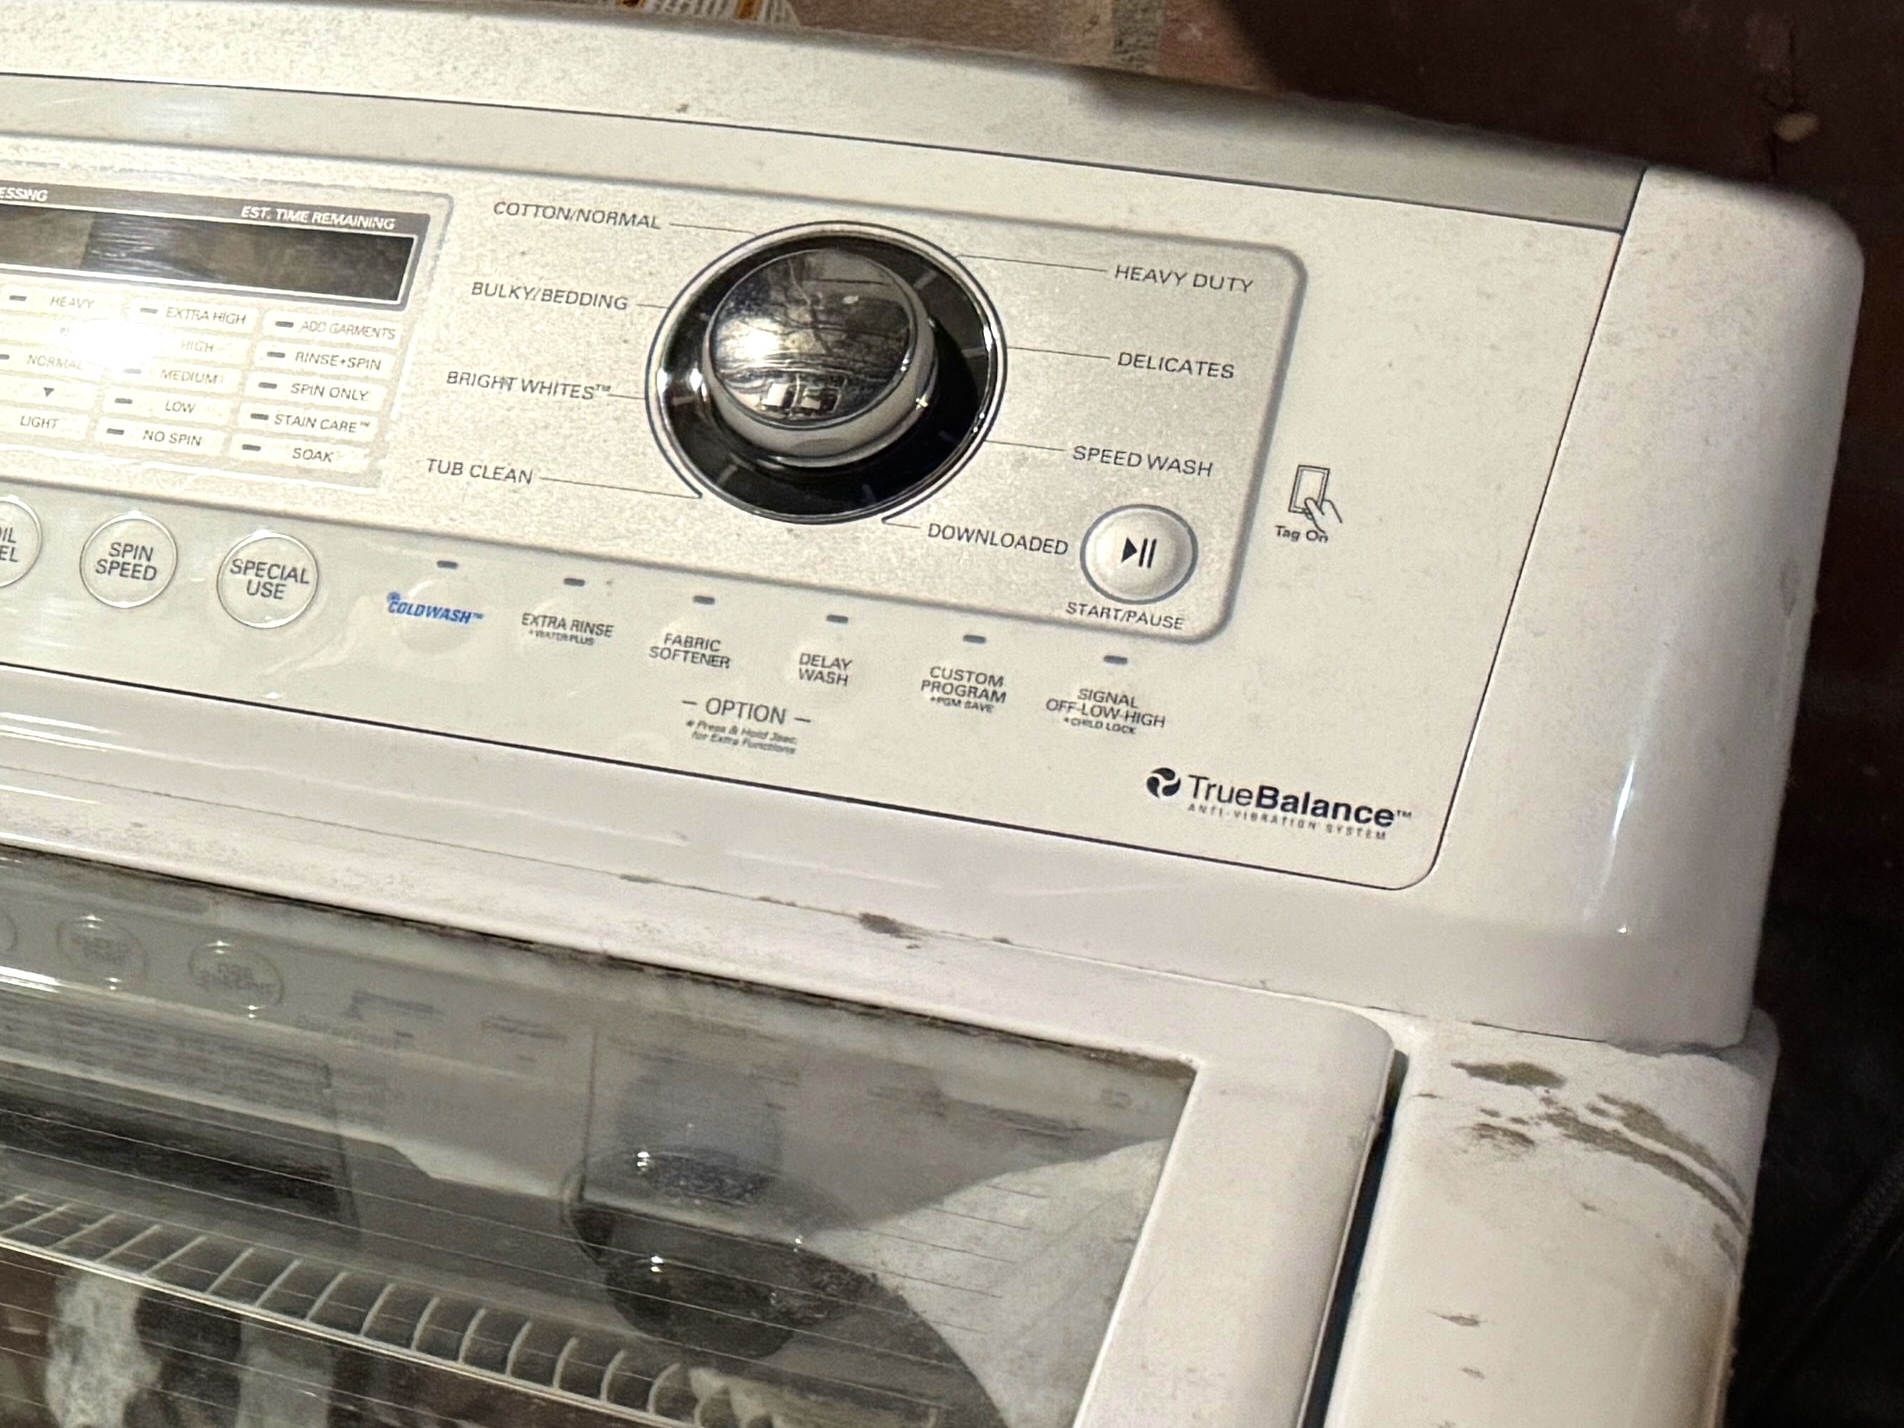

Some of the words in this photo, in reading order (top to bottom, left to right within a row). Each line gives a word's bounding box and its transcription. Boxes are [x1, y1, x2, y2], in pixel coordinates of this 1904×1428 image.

[241, 205, 272, 220] EST.
[275, 208, 309, 223] TIME
[311, 211, 396, 230] REMAINING
[493, 201, 662, 230] COTTON/NORMAL
[1114, 264, 1188, 287] HEAVY
[1192, 273, 1254, 294] DUTY
[471, 281, 629, 311] BULKY/BEDDING
[166, 307, 209, 322] EXTRA
[213, 312, 247, 326] HIGH
[299, 320, 327, 333] ADD
[328, 322, 396, 340] GARMENTS
[295, 351, 382, 371] RINSE+SPIN
[1117, 351, 1235, 380] DELICATES
[290, 383, 325, 398] SPIN
[328, 385, 369, 401] ONLY
[446, 371, 517, 392] BRIGHT
[165, 400, 196, 414] LOW
[20, 415, 60, 430] LIGHT
[274, 414, 317, 429] STAIN
[142, 430, 166, 444] NO
[168, 432, 203, 447] SPIN
[292, 447, 334, 463] SOAK
[1072, 445, 1142, 469] SPEED
[1146, 453, 1213, 478] WASH
[427, 458, 464, 476] TUB
[469, 464, 534, 484] CLEAN
[927, 522, 1069, 556] DOWNLOADED
[1275, 524, 1300, 542] Tag
[1306, 528, 1329, 543] On
[109, 542, 154, 562] SPIN
[95, 559, 158, 582] SPEED
[229, 558, 310, 585] SPECIAL
[246, 579, 286, 600] USE
[521, 612, 567, 631] EXTRA
[570, 619, 614, 638] RINSE
[1066, 601, 1185, 631] START/PAUSE
[663, 633, 721, 652] FABRIC
[648, 646, 731, 669] SOFTENER
[799, 652, 852, 672] DELAY
[798, 667, 849, 687] WASH
[930, 666, 1004, 688] CUSTOM
[921, 679, 1007, 704] PROGRAM
[1077, 688, 1139, 709] SIGNAL
[705, 696, 787, 725] OPTION
[1045, 698, 1166, 729] OFF-LOW-HIGH
[1188, 803, 1317, 830] ANTI-VIBRATION
[1326, 824, 1387, 840] SYSTEM
